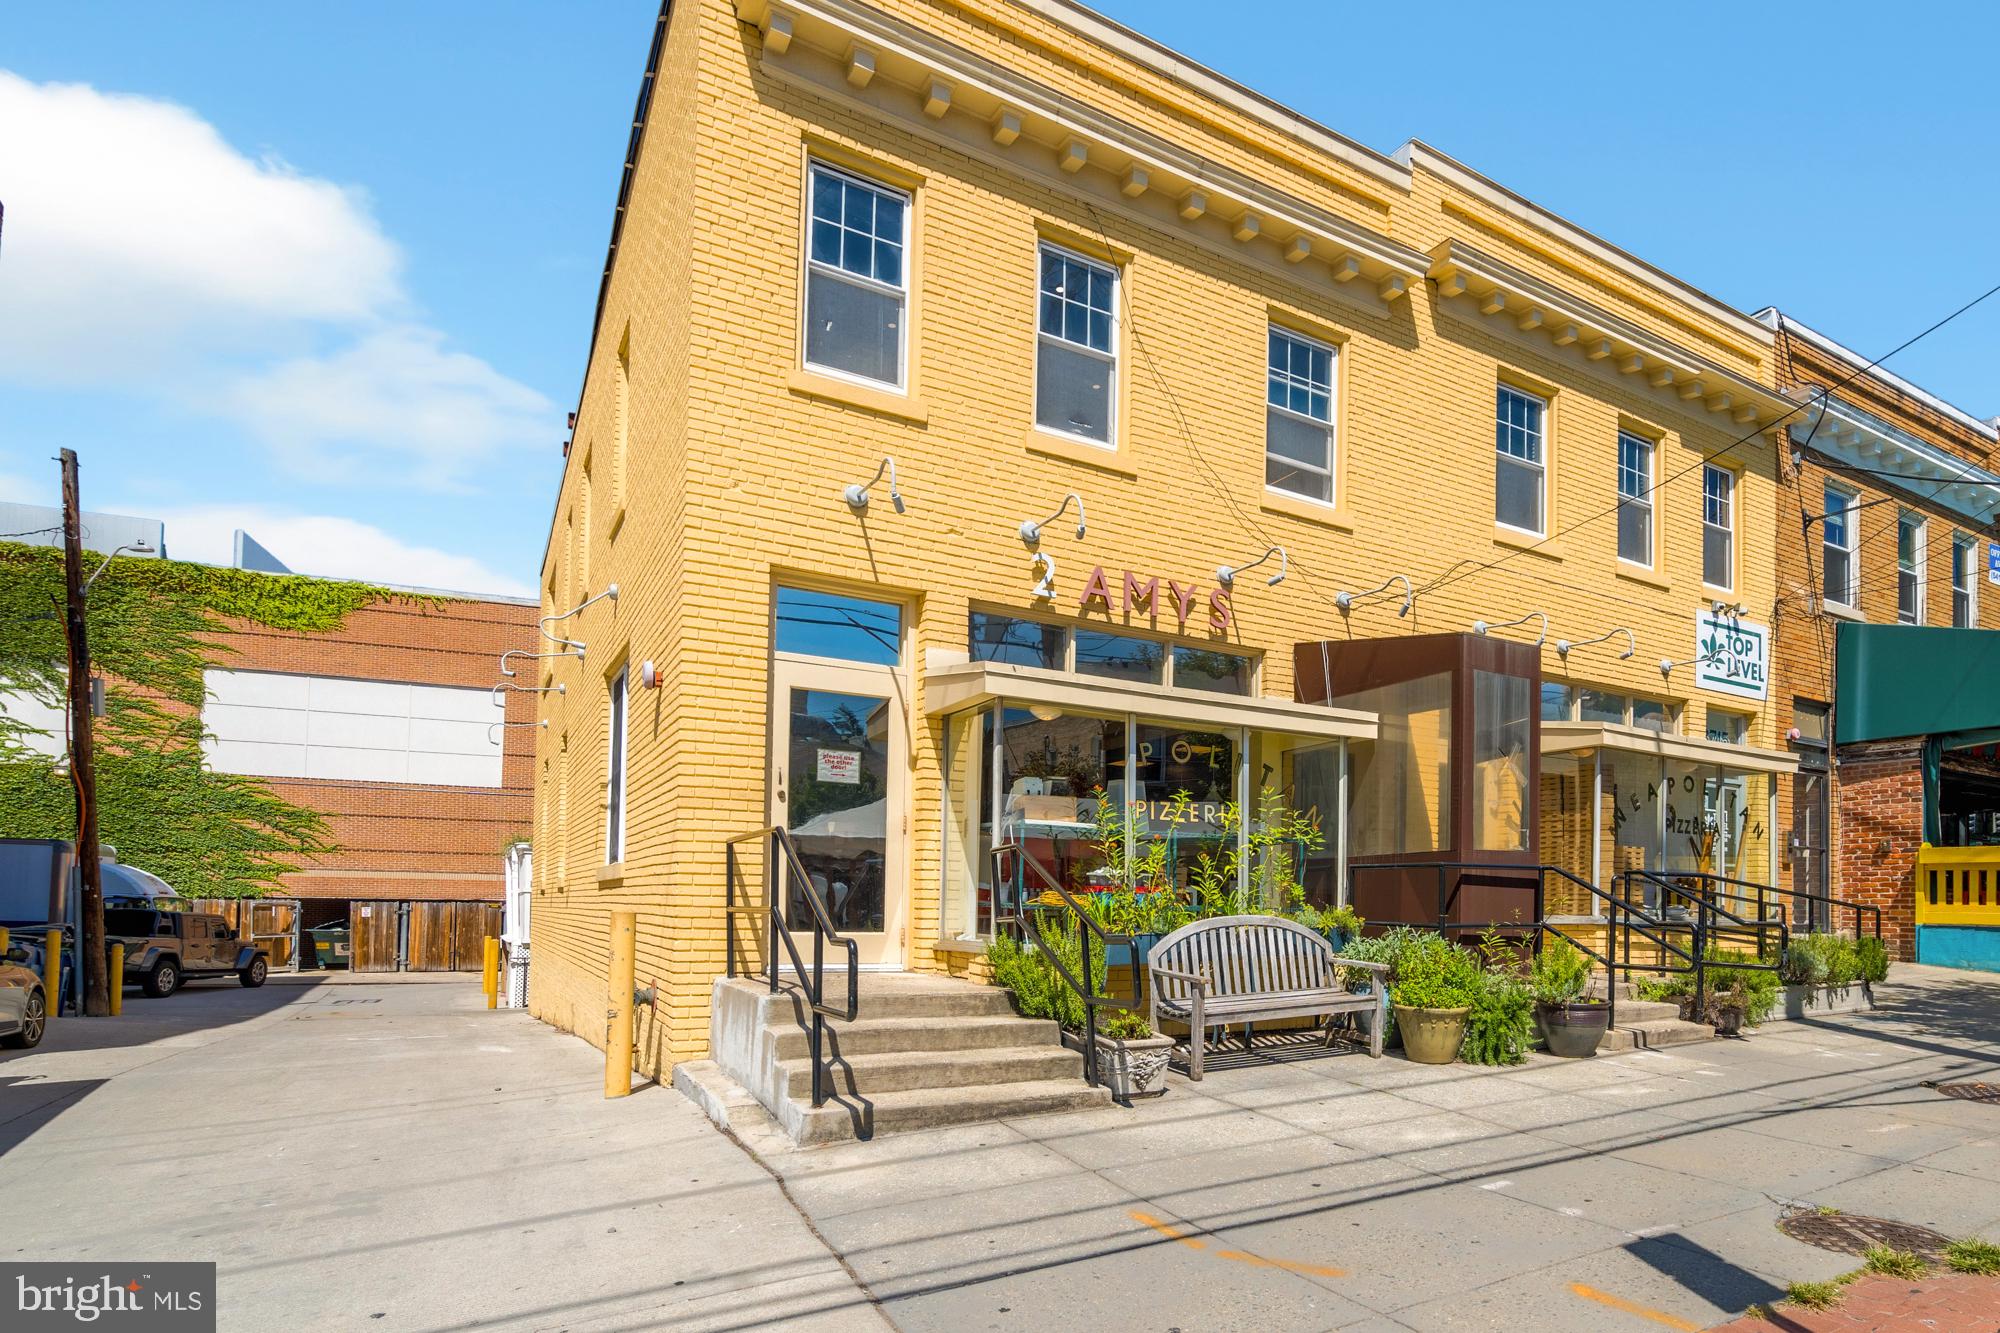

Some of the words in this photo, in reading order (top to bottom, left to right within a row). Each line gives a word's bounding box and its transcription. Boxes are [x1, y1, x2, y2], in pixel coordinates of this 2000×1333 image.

[1030, 551, 1057, 598] 2
[1078, 565, 1231, 629] AMYS
[1725, 633, 1753, 657] TOP
[1727, 657, 1765, 683] LVEL
[1136, 800, 1241, 831] PIZZERI
